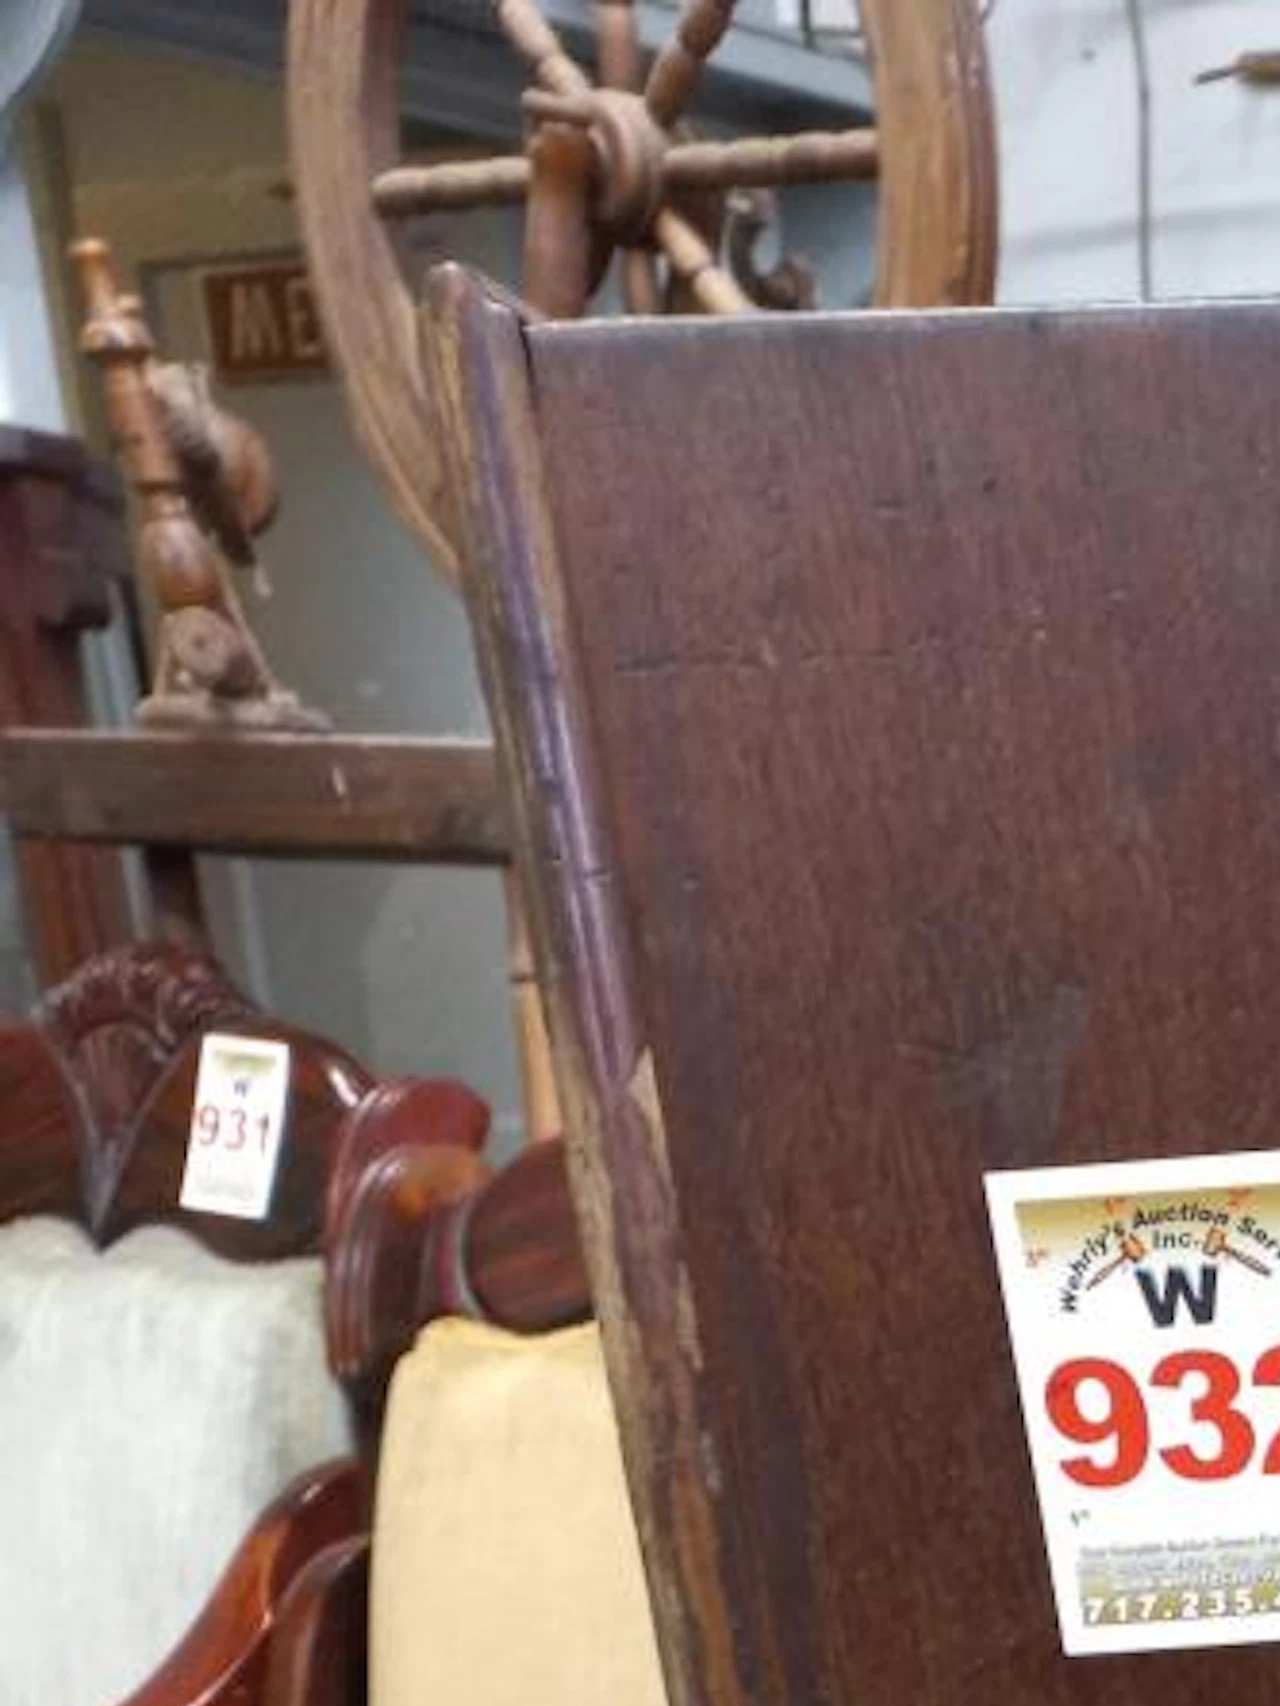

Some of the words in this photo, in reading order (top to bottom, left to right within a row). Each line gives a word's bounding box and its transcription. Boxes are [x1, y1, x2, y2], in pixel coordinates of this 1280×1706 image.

[230, 278, 322, 357] ME
[199, 1105, 270, 1154] 931
[1059, 1219, 1126, 1313] Wehrly's
[1133, 1201, 1230, 1229] Auction
[1153, 1230, 1199, 1250] Inc.
[1134, 1264, 1219, 1328] W
